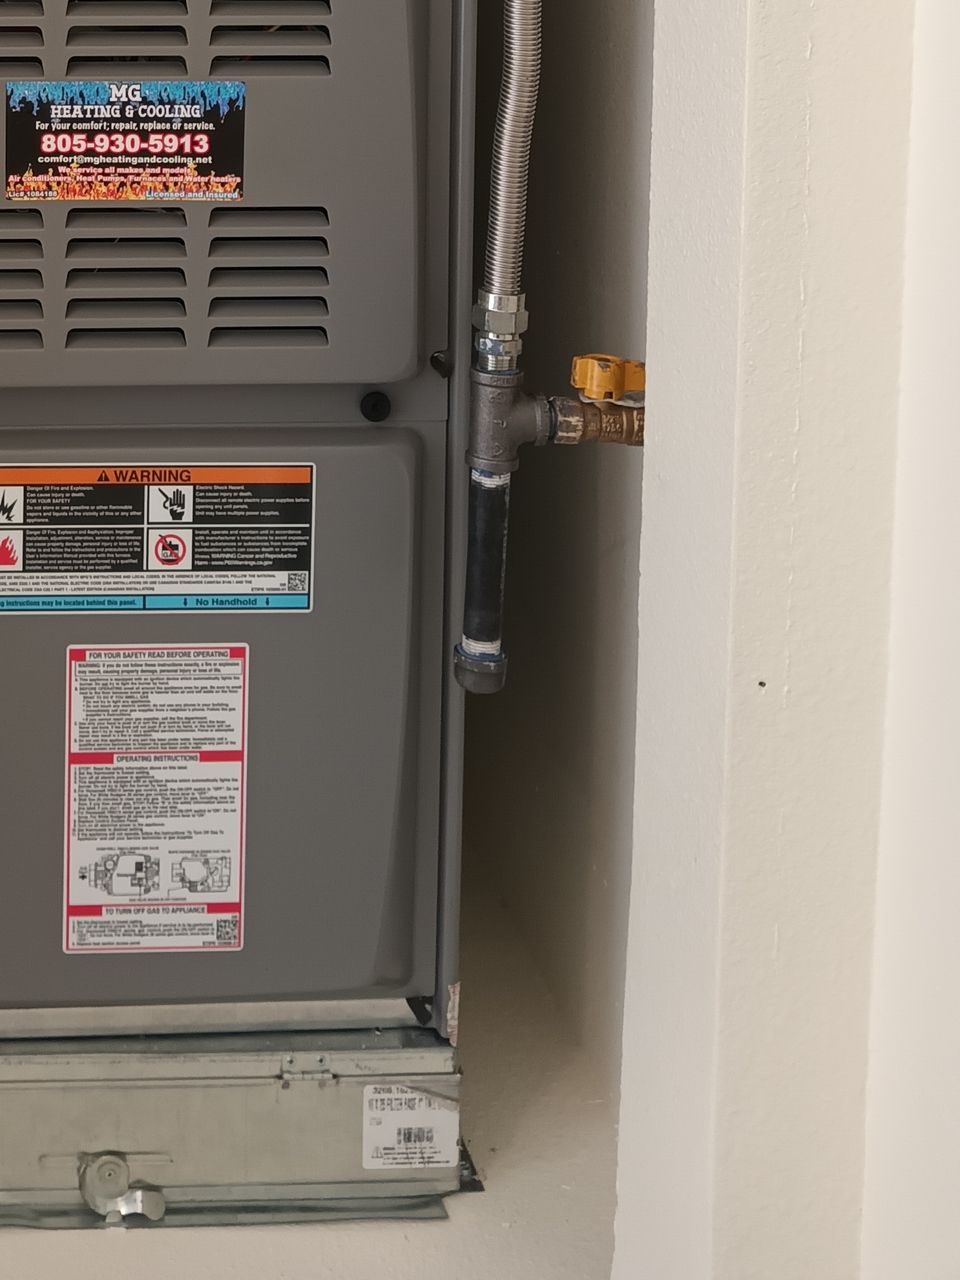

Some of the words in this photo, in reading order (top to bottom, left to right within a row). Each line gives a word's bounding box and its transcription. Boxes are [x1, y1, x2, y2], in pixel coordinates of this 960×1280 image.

[109, 84, 142, 102] MG
[50, 104, 121, 118] HEATING
[125, 104, 135, 118] &
[138, 104, 201, 118] COOLING
[35, 120, 48, 131] For
[50, 121, 70, 132] your
[72, 120, 110, 131] comfort;
[111, 120, 138, 132] repair,
[140, 120, 171, 132] replace
[172, 122, 182, 131] or
[183, 120, 215, 131] service.
[41, 133, 209, 154] 805-930-5913
[37, 154, 213, 165] comfort@mgheatingandcooling.net
[58, 166, 68, 174] We
[104, 166, 115, 174] all
[117, 166, 144, 174] makes
[146, 166, 161, 174] and
[76, 175, 96, 183] Heat
[206, 191, 238, 199] Insured
[114, 469, 191, 482] WARNING
[6, 599, 40, 608] instructions
[41, 599, 54, 607] may
[55, 599, 63, 607] be
[63, 599, 85, 607] located
[86, 599, 106, 607] behind
[107, 599, 118, 607] this
[195, 598, 209, 606] No
[211, 598, 258, 606] Handhold
[89, 651, 100, 659] FOR
[103, 651, 121, 659] YOUR
[122, 651, 146, 659] SAFETY
[148, 651, 165, 659] READ
[116, 754, 153, 763] OPERATING
[154, 754, 198, 763] INSTRUCTIONS
[105, 908, 114, 916] TO
[147, 907, 161, 915] GAS
[161, 907, 170, 915] TO
